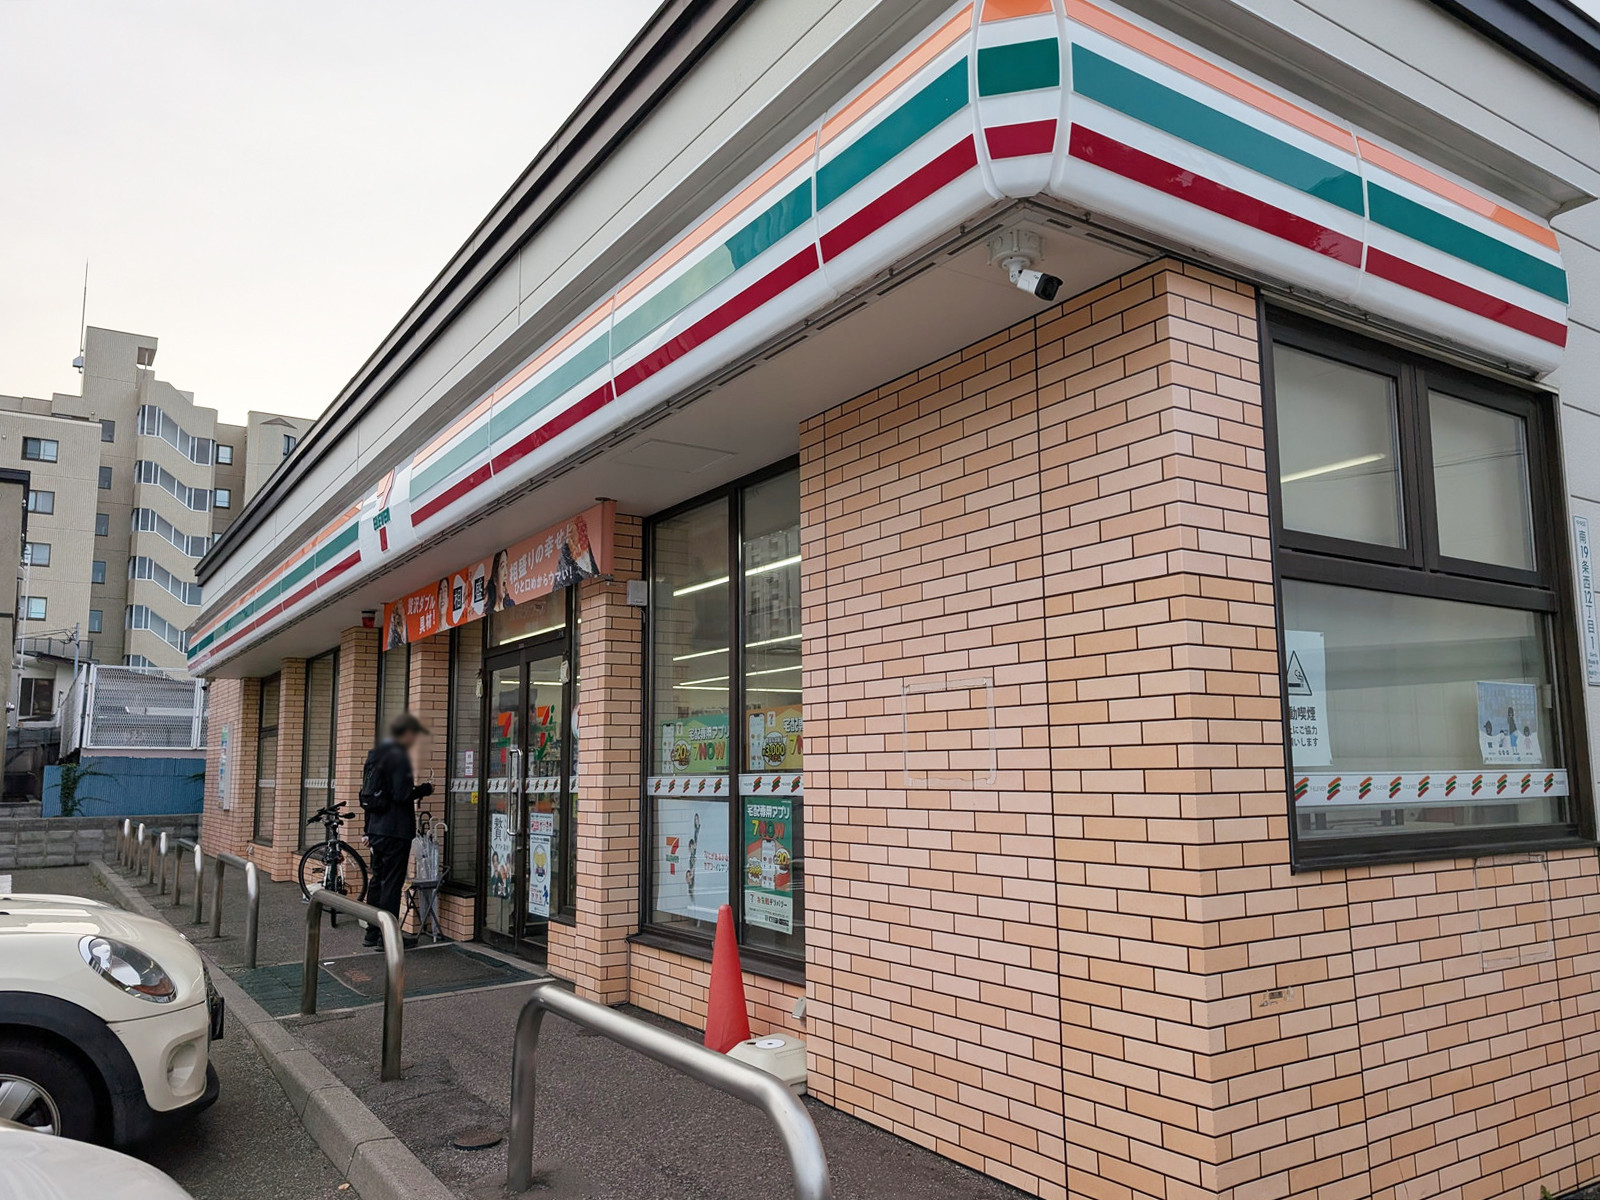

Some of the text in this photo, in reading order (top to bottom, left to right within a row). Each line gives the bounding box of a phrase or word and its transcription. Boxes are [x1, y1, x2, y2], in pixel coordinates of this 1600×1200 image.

[693, 741, 726, 760] 7NOW
[1291, 737, 1318, 747] いします
[747, 804, 790, 819] 宅配専用アプリ
[751, 819, 786, 839] 7NOW
